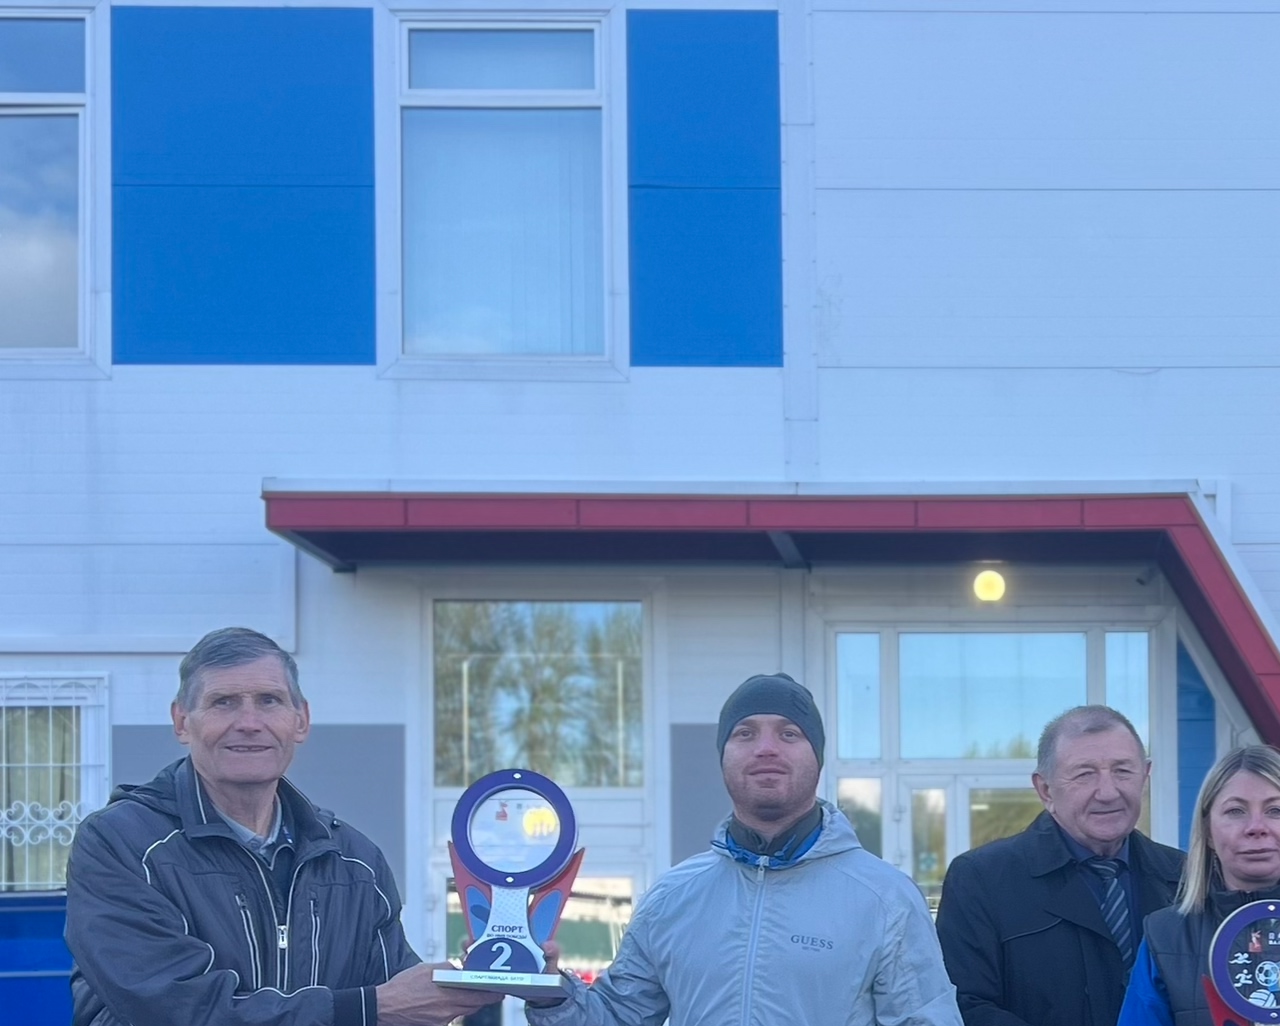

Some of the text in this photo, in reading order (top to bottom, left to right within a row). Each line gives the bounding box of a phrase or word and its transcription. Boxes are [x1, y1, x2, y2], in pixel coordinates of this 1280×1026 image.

[491, 924, 523, 933] СПОРТ
[790, 934, 833, 950] GUESS
[490, 941, 512, 970] 2
